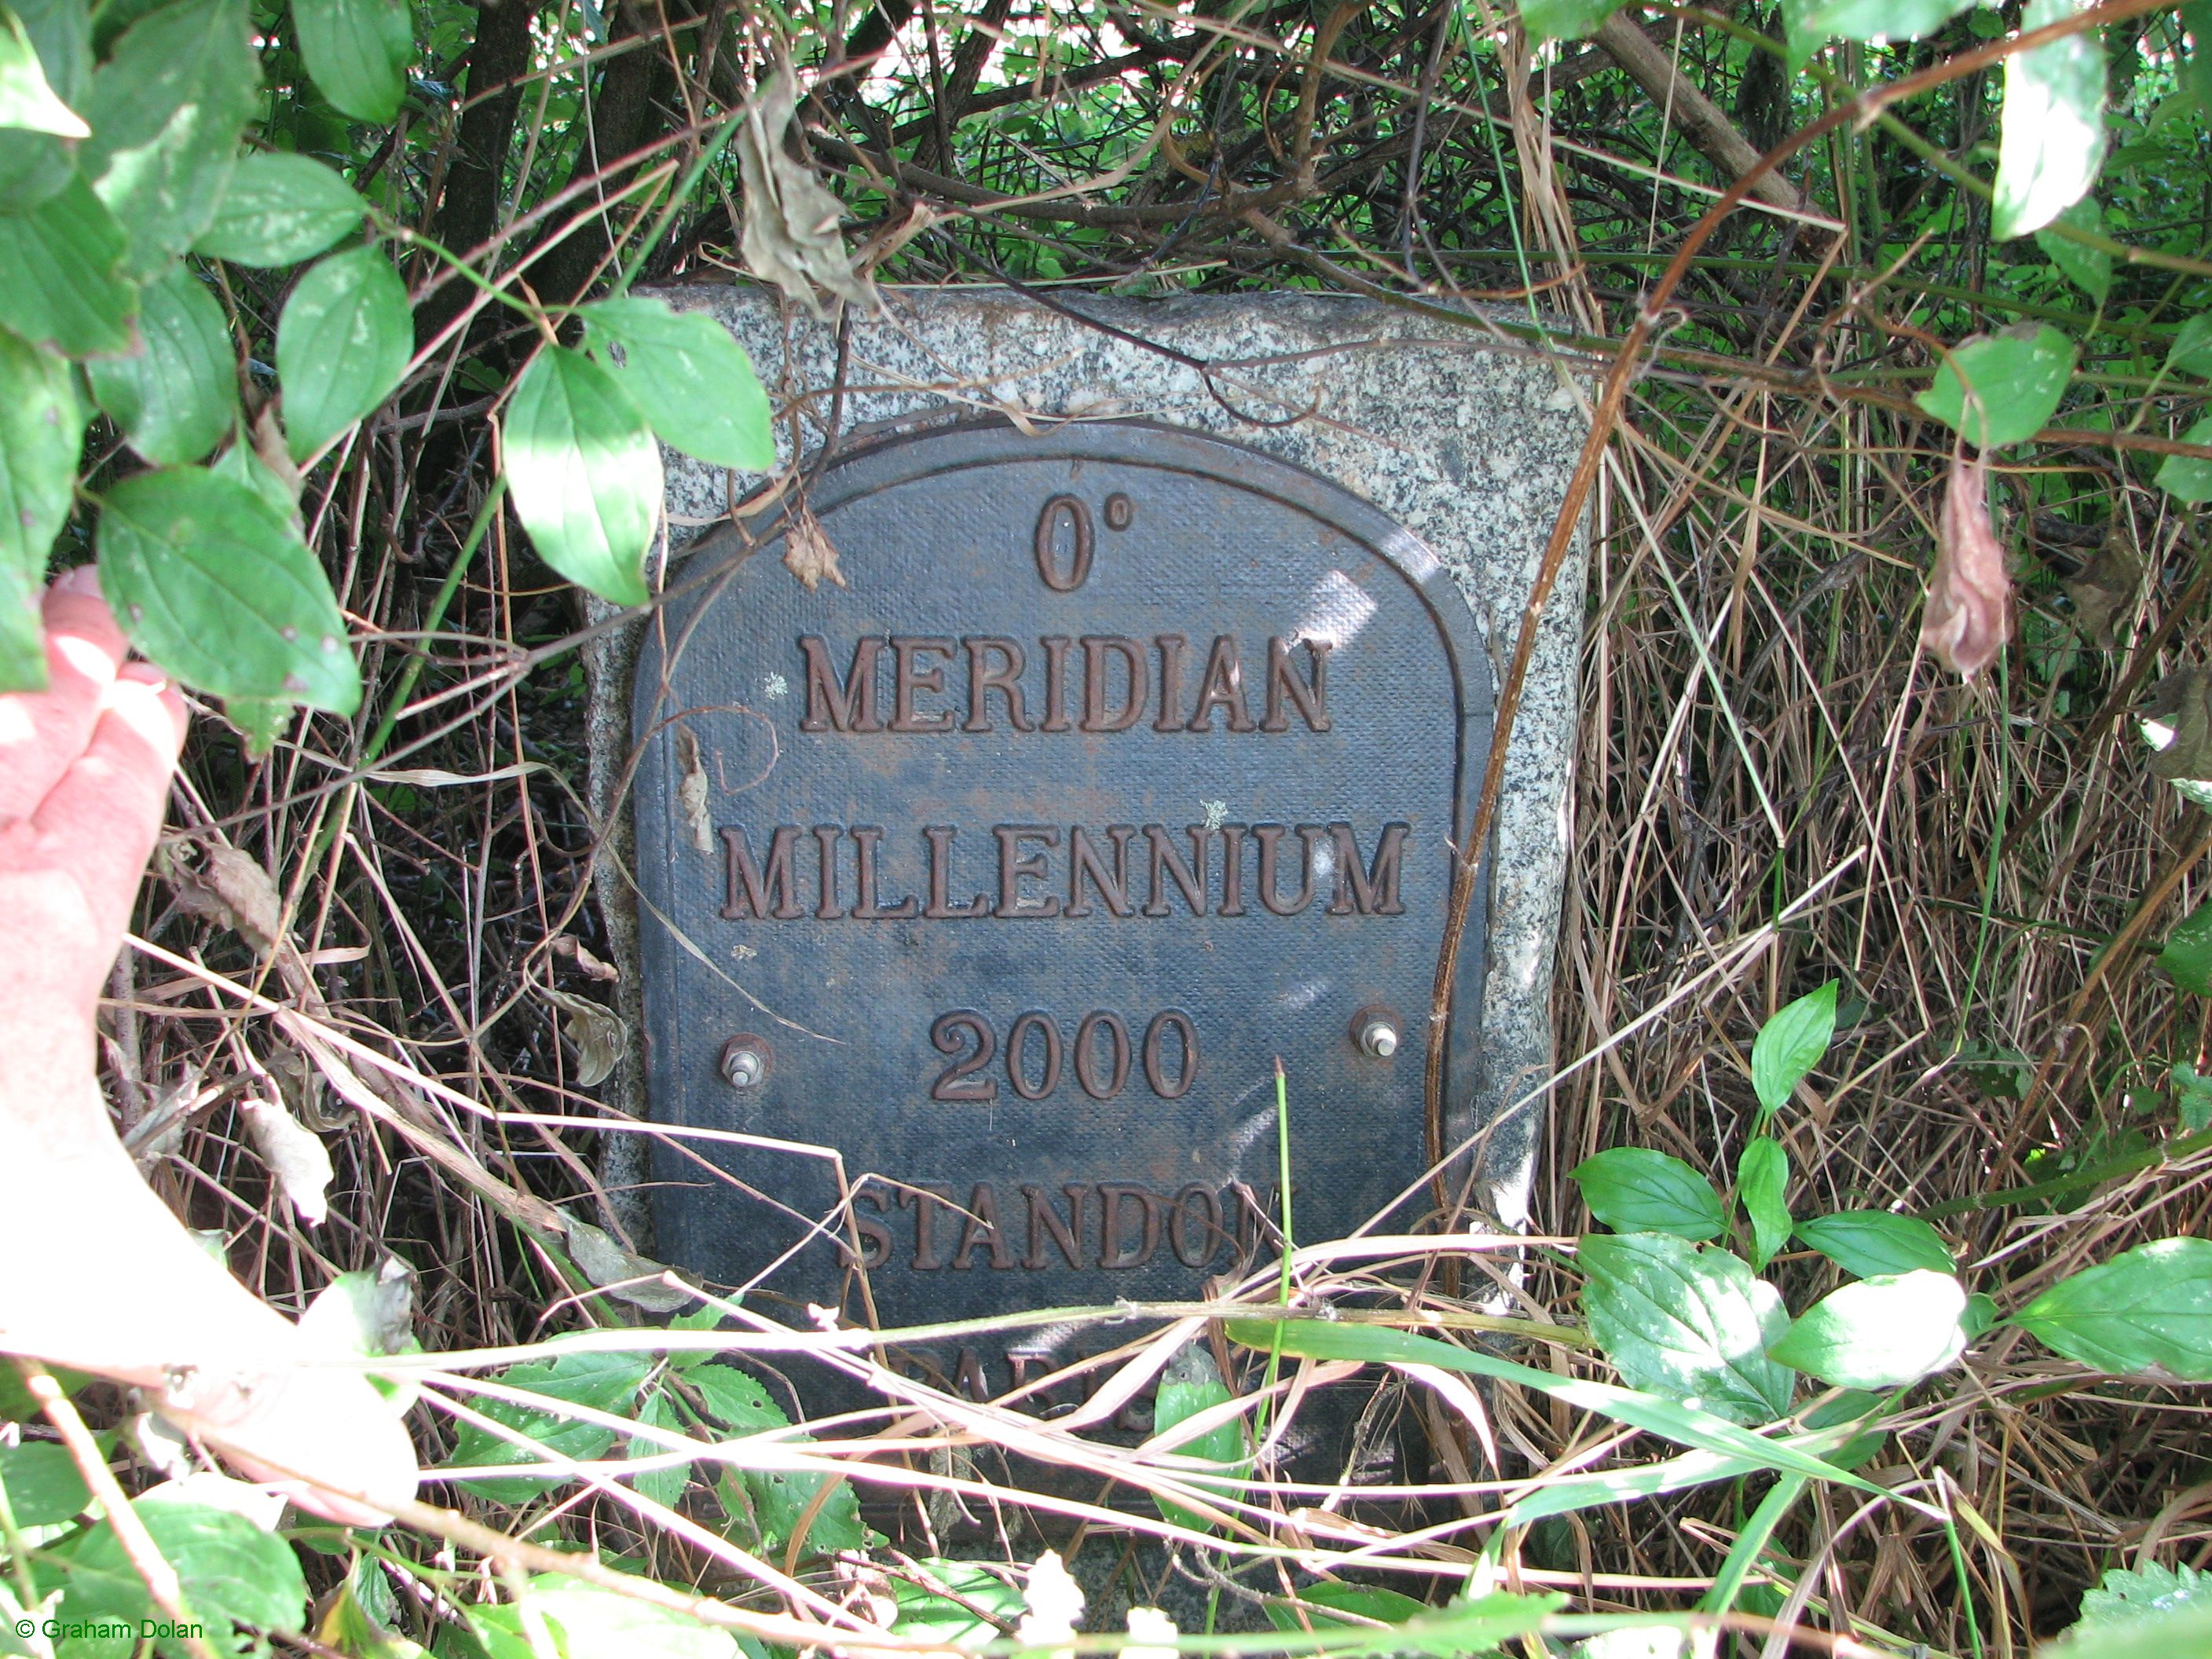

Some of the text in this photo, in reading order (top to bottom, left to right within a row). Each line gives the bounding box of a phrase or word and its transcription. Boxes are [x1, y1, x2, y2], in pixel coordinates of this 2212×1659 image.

[799, 633, 1334, 734] MERIDIAN
[718, 822, 1411, 921] MILLENNIUM
[931, 1008, 1199, 1101] 2000
[838, 1180, 1298, 1271] STANDON
